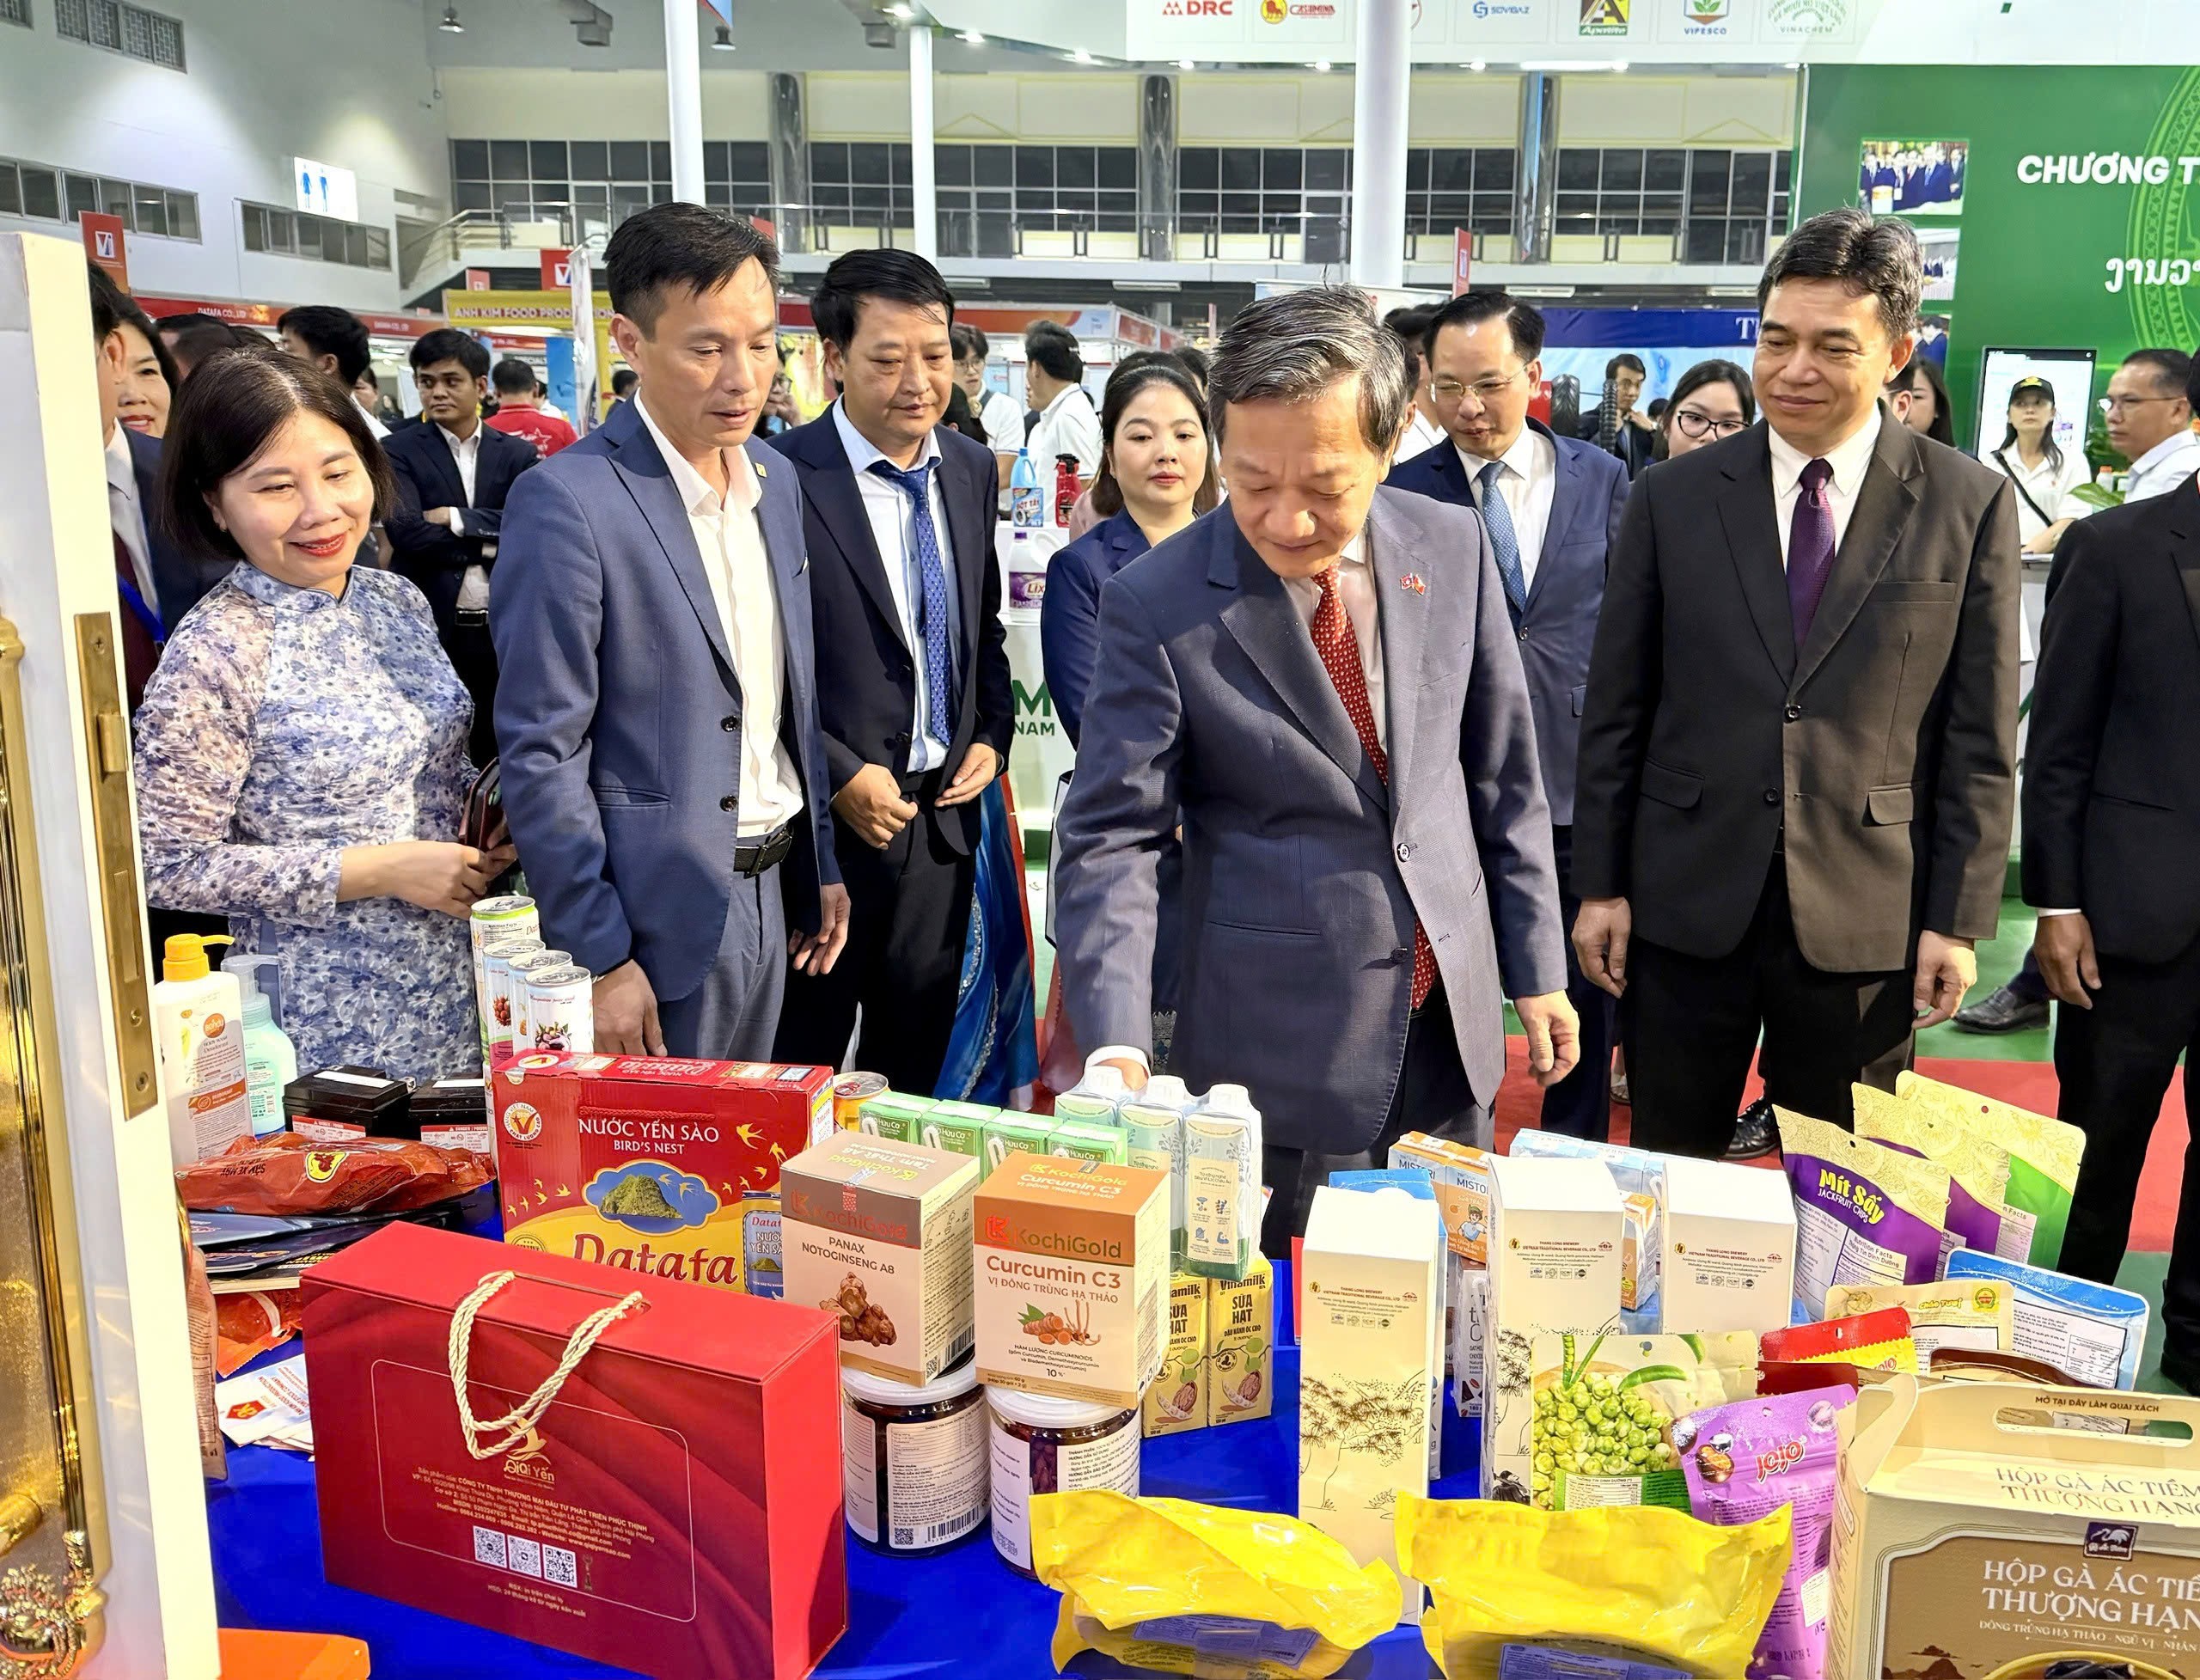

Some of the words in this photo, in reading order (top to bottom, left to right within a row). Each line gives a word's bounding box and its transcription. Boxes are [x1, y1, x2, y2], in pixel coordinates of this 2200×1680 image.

[1187, 1, 1232, 15] DRC
[2017, 151, 2170, 185] CHƯƠNG
[455, 308, 477, 318] ANH
[481, 309, 502, 318] KIM
[504, 309, 537, 318] FOOD
[1027, 582, 1044, 593] Lix
[578, 1117, 634, 1137] NƯỚC
[681, 1122, 719, 1143] SÀO
[655, 1143, 684, 1155] NEST
[1019, 1174, 1096, 1191] Curcumin
[1099, 1185, 1121, 1195] C3
[1047, 1168, 1128, 1186] KochiGold
[1817, 1188, 1854, 1210] JACKFRUIT
[1854, 1205, 1869, 1224] CHIPS
[1818, 1168, 1852, 1197] Mít
[1853, 1185, 1885, 1225] Sấy
[813, 1203, 908, 1241] KochiGold
[2008, 1208, 2027, 1220] Facts
[828, 1237, 865, 1255] PANAX
[1013, 1225, 1121, 1259] KochiGold
[573, 1233, 738, 1286] Datafa
[802, 1242, 877, 1271] NOTOGINSENG
[880, 1263, 895, 1274] A8
[1874, 1248, 1892, 1260] Facts
[987, 1254, 1086, 1285] Curcumin
[1091, 1271, 1121, 1289] C3
[987, 1275, 999, 1288] VỊ
[1033, 1282, 1069, 1298] TRÙNG
[1072, 1290, 1086, 1301] HẠ
[1170, 1283, 1201, 1298] amilk
[1232, 1293, 1253, 1310] SỮA
[1232, 1308, 1253, 1325] HẠT
[1049, 1350, 1093, 1362] CURCUMINOIDS
[2035, 1396, 2050, 1404] MỞ
[2053, 1397, 2067, 1408] TẠI
[2069, 1396, 2087, 1408] ĐÂY
[2088, 1398, 2107, 1409] LÀM
[2110, 1402, 2132, 1411] QUAI
[2134, 1402, 2160, 1412] XÁCH
[533, 1465, 555, 1482] Yến
[1995, 1467, 2048, 1488] HỘP
[2055, 1472, 2093, 1491] GÀ
[2101, 1475, 2134, 1494] ÁC
[2001, 1485, 2124, 1512] THƯỢNG
[1983, 1557, 2047, 1586] HỘP
[2053, 1563, 2096, 1590] GÀ
[2105, 1566, 2148, 1595] ÁC
[1982, 1587, 2122, 1622] THƯỢNG
[1979, 1619, 2011, 1631] ĐÔNG
[2052, 1628, 2069, 1639] HẠ
[2114, 1634, 2139, 1645] NGŨ
[2141, 1639, 2154, 1649] VỊ
[2163, 1639, 2197, 1652] NHÂN
